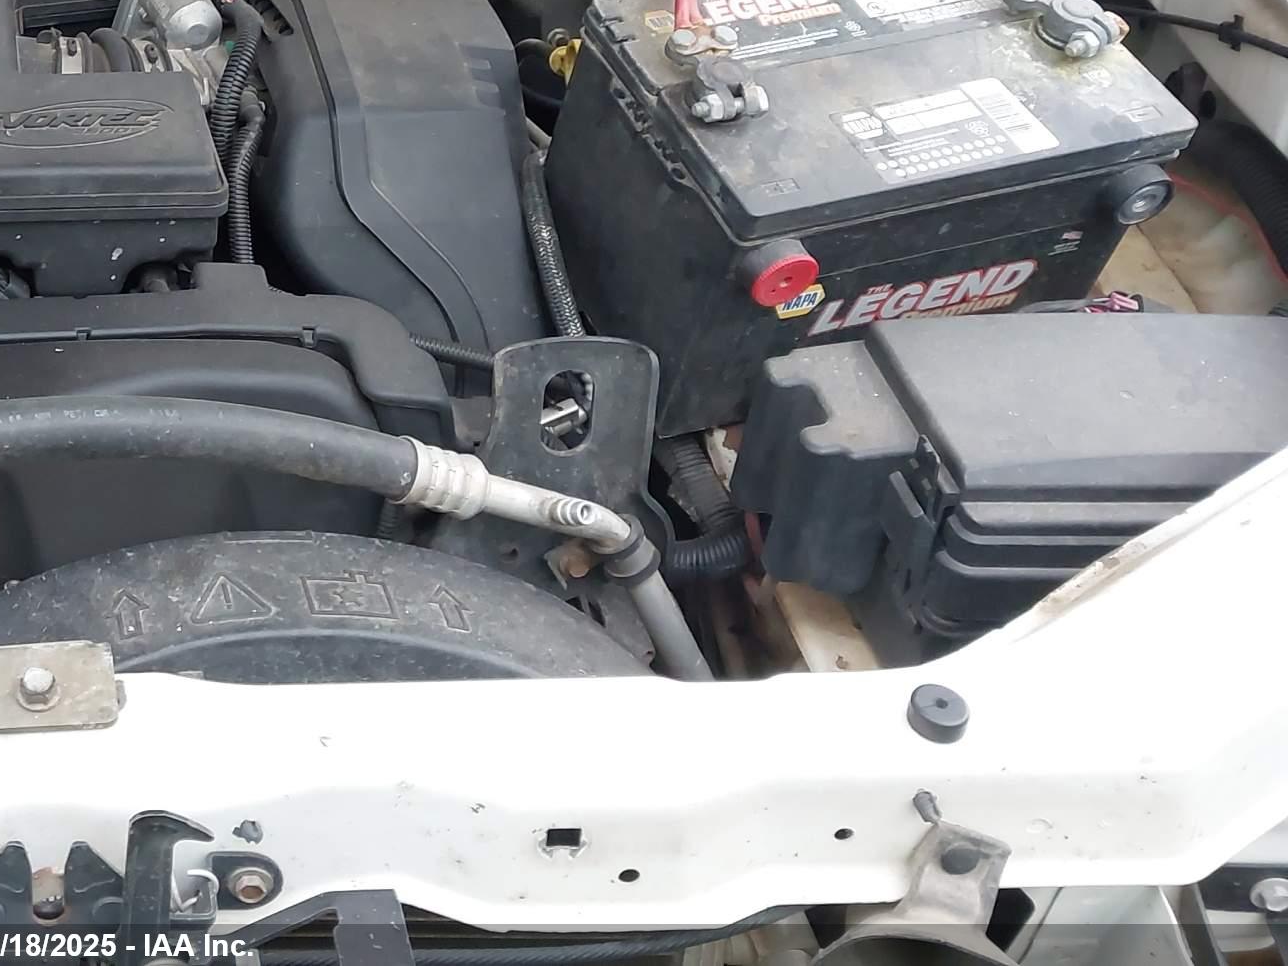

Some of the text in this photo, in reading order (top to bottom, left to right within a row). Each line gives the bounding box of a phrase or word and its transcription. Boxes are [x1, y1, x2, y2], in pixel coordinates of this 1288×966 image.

[759, 2, 841, 27] Premium
[808, 259, 1038, 337] LEGEND
[868, 283, 892, 295] THE
[782, 292, 819, 311] NAPA
